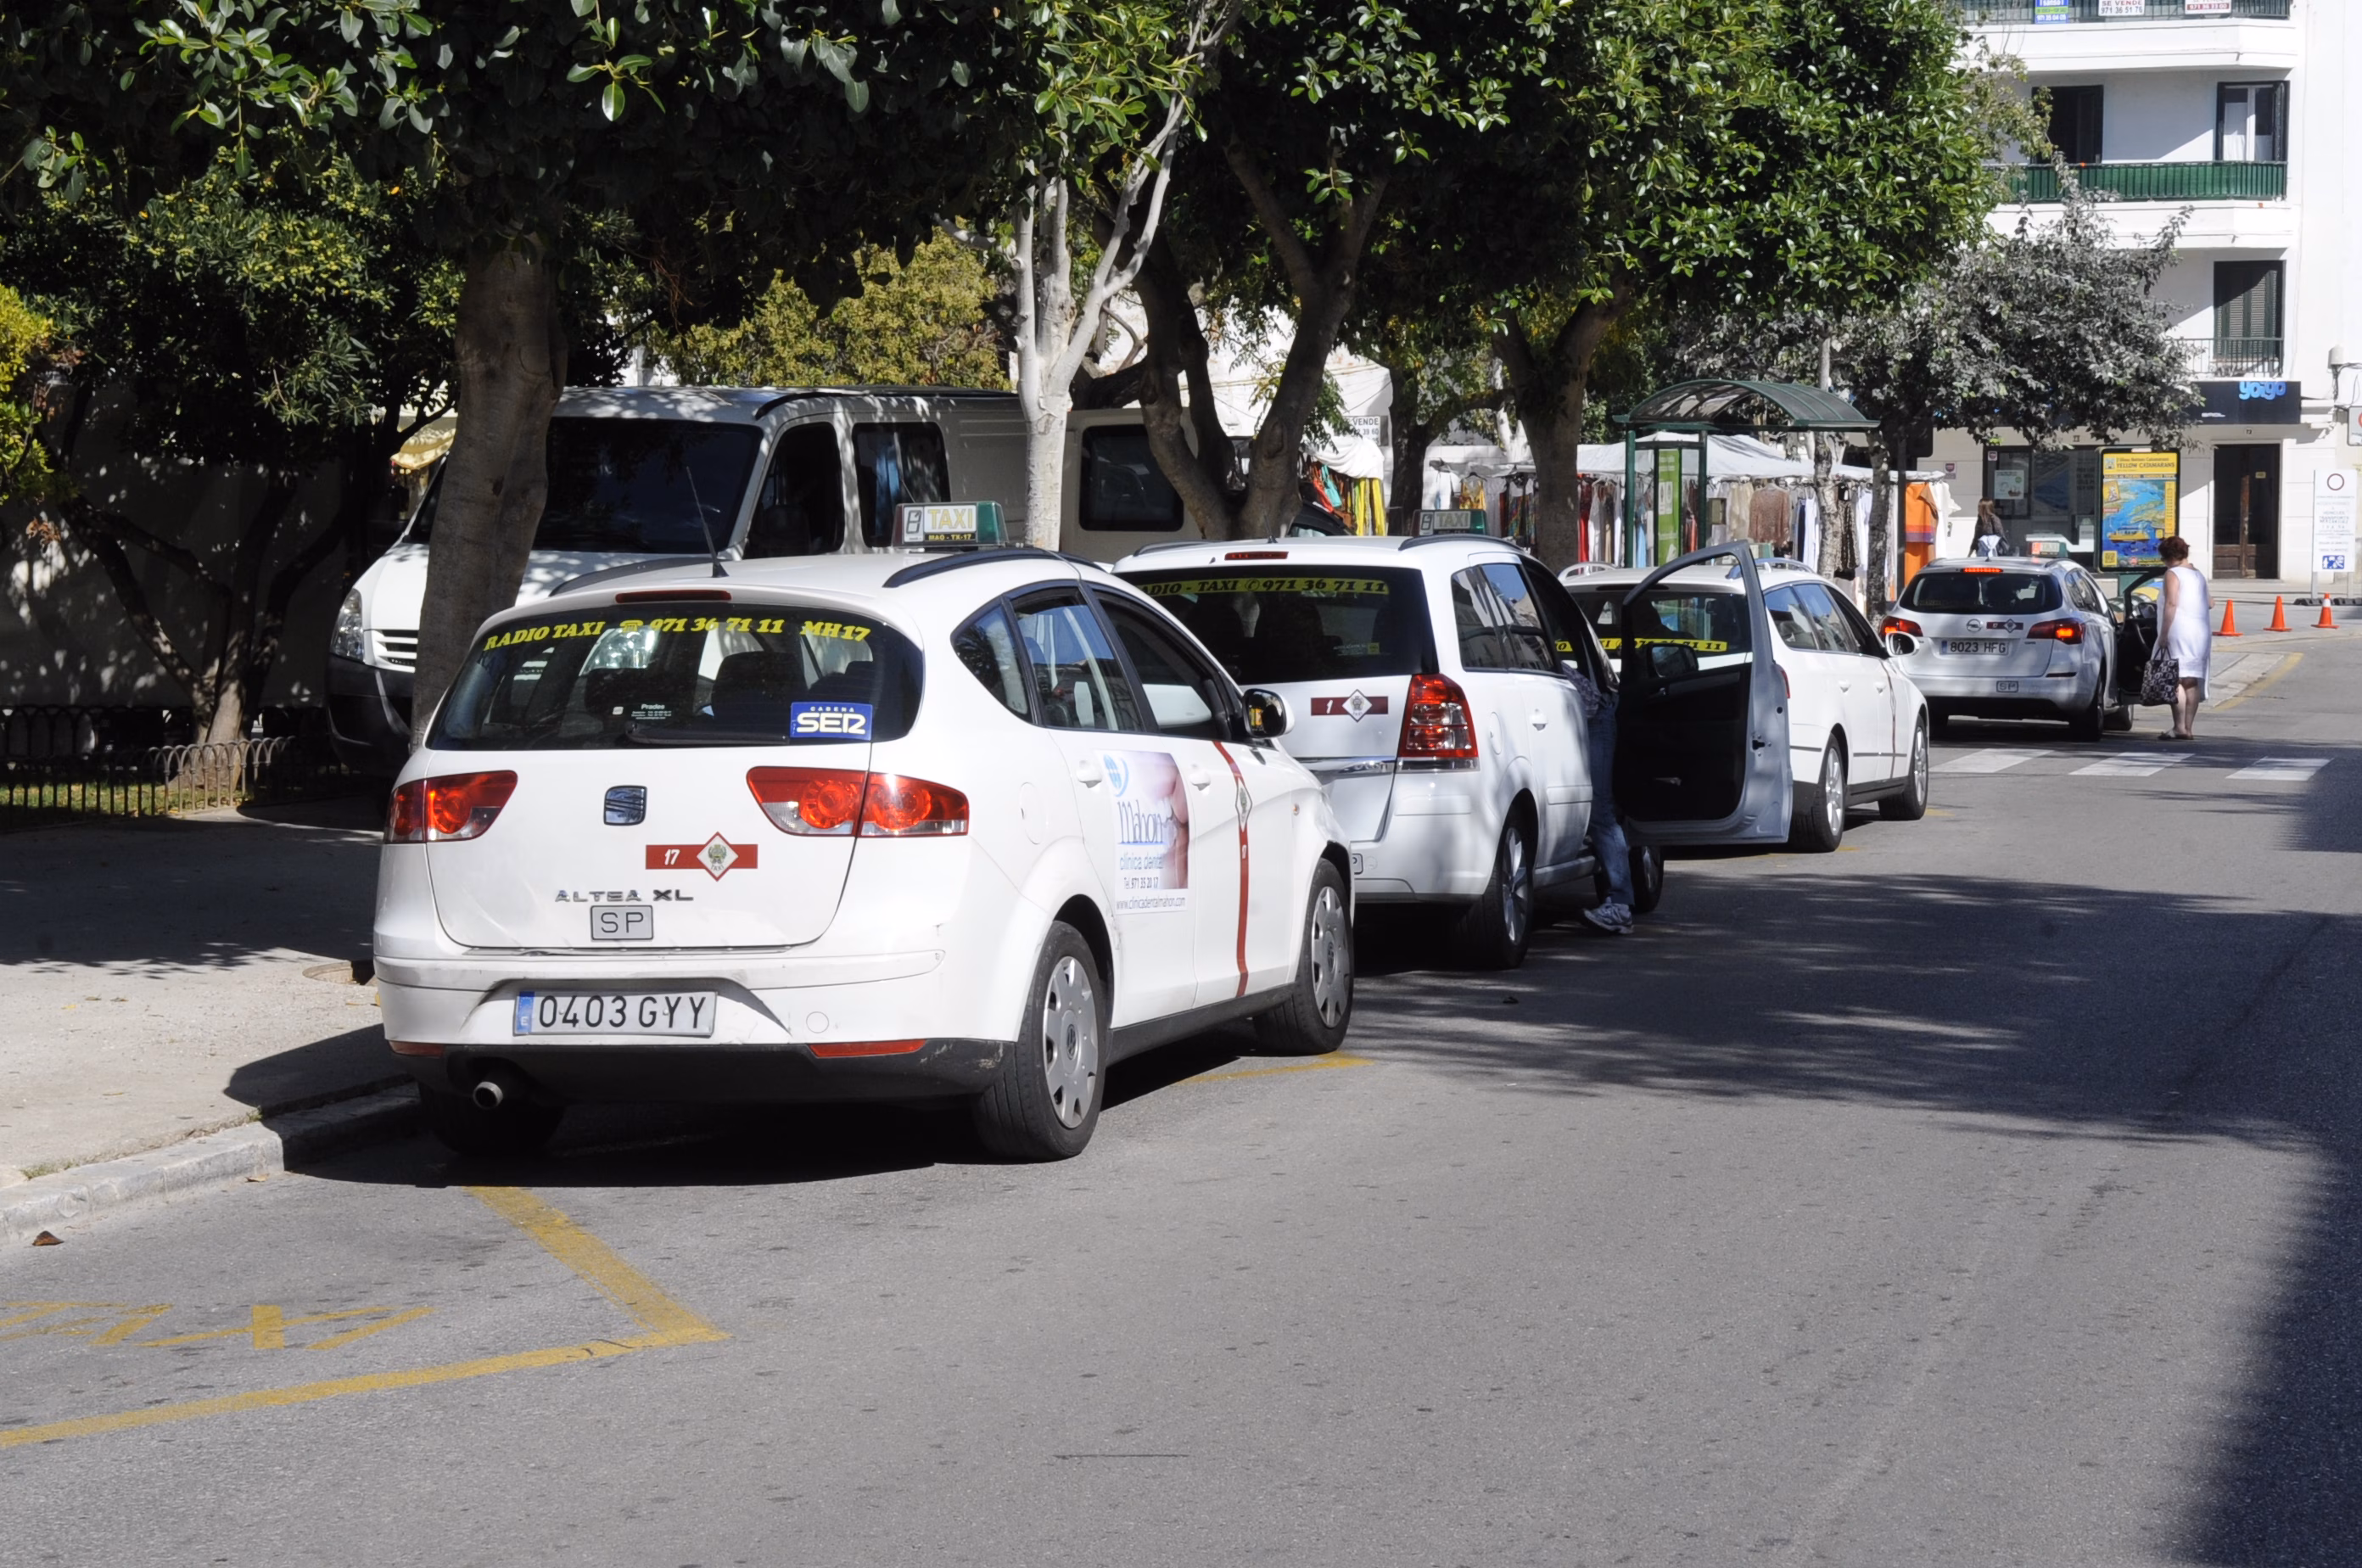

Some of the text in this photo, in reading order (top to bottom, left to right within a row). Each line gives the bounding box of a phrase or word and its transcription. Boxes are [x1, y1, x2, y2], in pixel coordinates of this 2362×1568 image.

[2239, 381, 2286, 400] yoigo
[927, 508, 973, 529] TAXI
[1436, 512, 1469, 528] TAXI
[1141, 582, 1182, 595] ADIO
[1198, 580, 1239, 592] TAXI
[1262, 580, 1296, 591] 971
[1302, 580, 1325, 591] 36
[1334, 580, 1355, 591] 71
[1363, 580, 1386, 592] 11
[484, 618, 871, 651] RADIO TAXI 971 36 71 11 MH17
[1705, 642, 1721, 651] 11
[1951, 642, 2006, 652] 8023 HFG
[1999, 682, 2016, 691] SP
[1327, 700, 1333, 714] 1
[797, 713, 866, 735] SER
[664, 848, 680, 865] 17
[555, 888, 694, 903] ALTEA XL
[601, 911, 644, 933] SP
[540, 994, 627, 1028] 0403
[639, 996, 706, 1029] GYY
